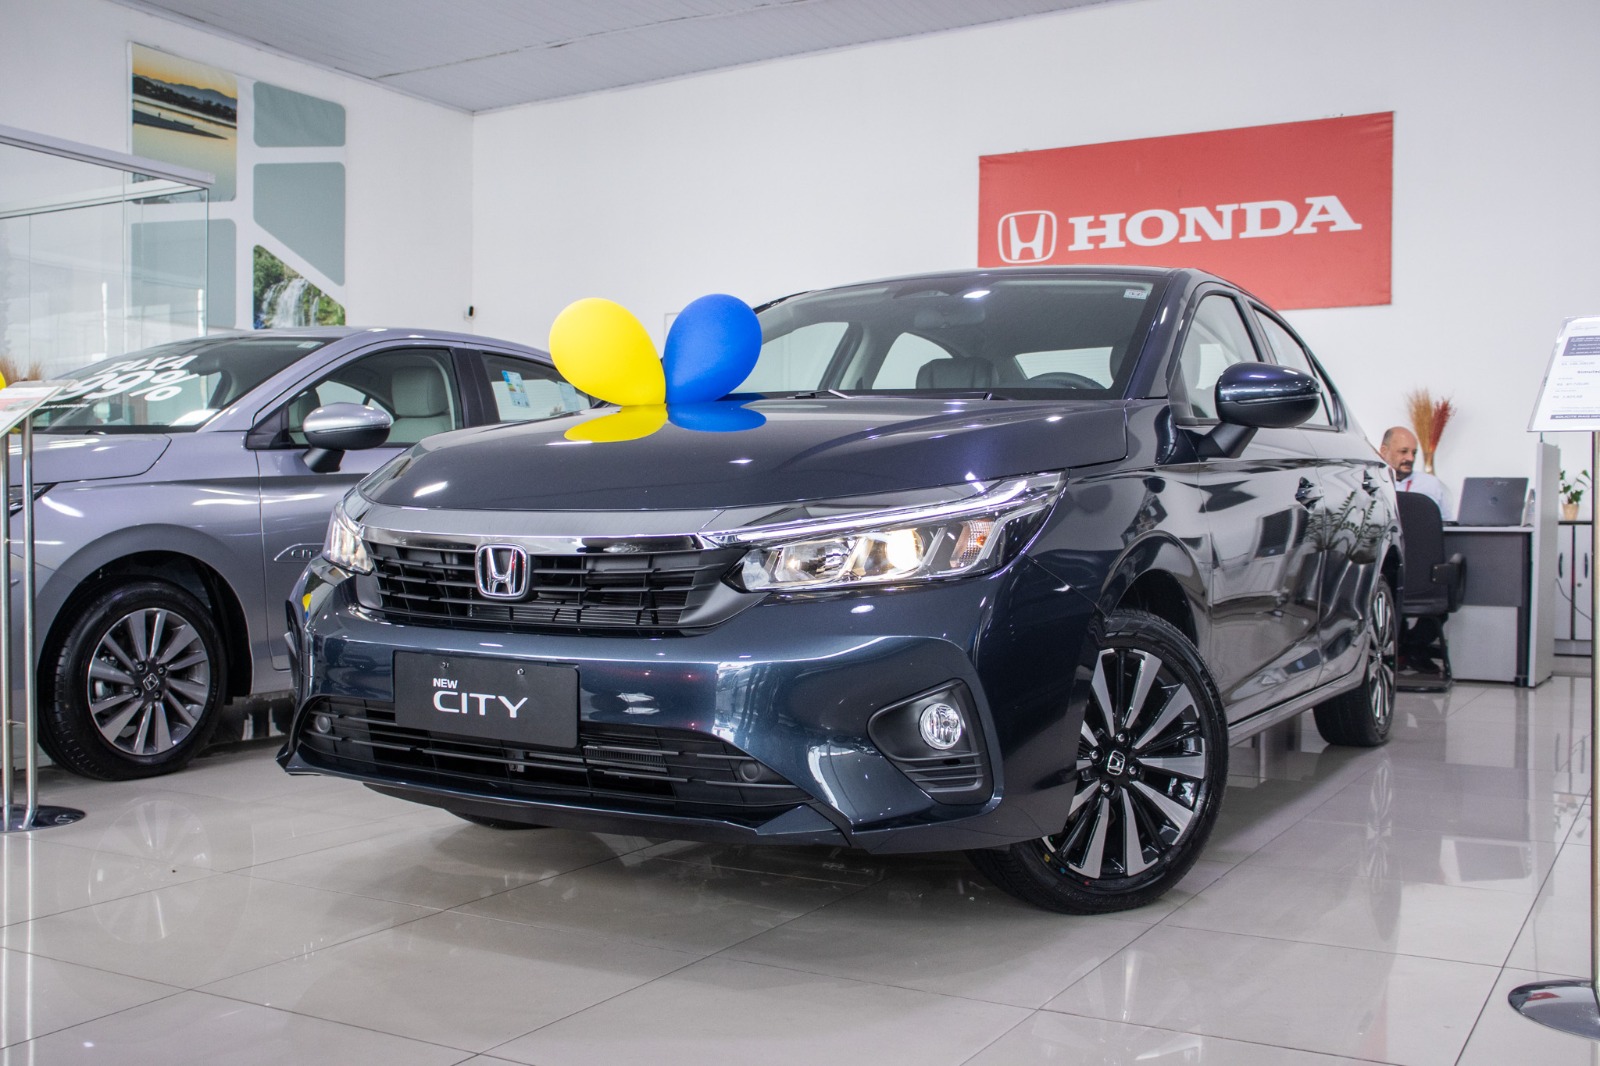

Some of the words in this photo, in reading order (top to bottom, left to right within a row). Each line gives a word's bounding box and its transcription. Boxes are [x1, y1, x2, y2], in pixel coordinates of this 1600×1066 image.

[1067, 195, 1362, 252] HONDA
[94, 355, 198, 376] TAXA
[432, 678, 458, 689] NEW
[433, 690, 528, 718] CITY
